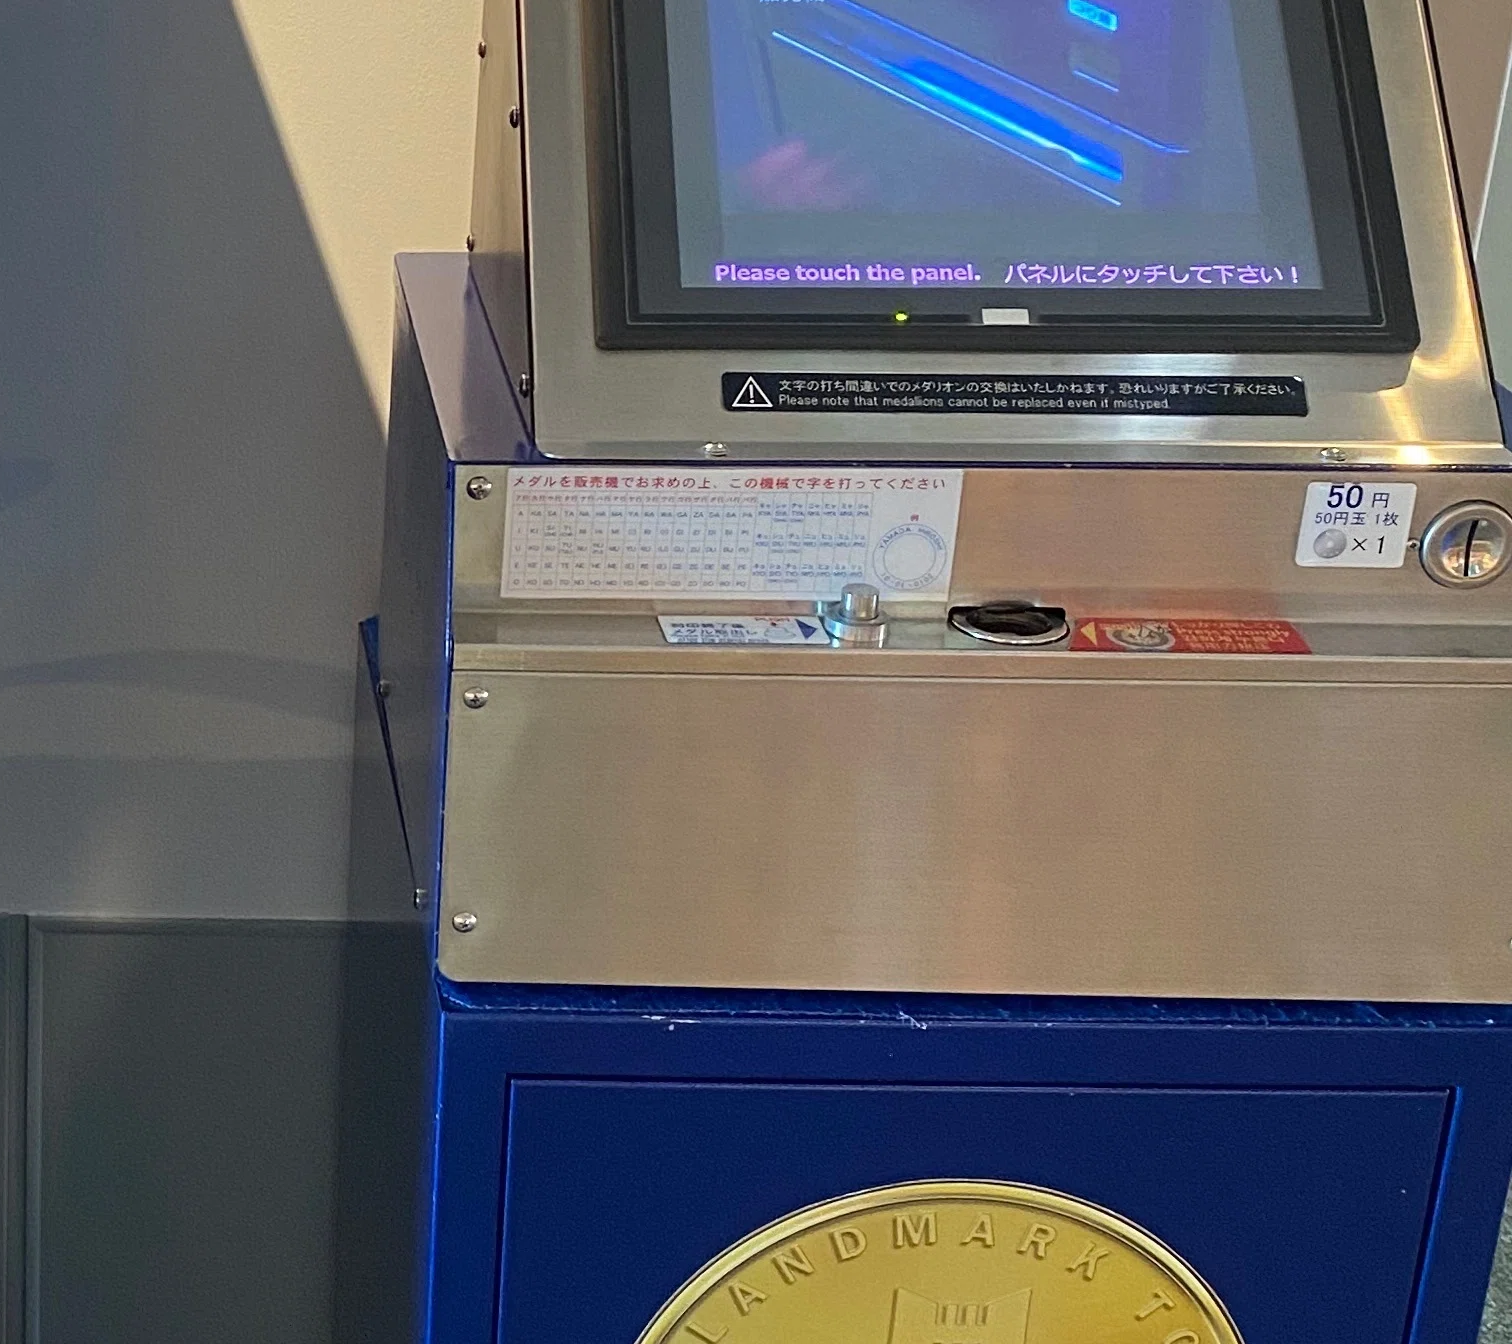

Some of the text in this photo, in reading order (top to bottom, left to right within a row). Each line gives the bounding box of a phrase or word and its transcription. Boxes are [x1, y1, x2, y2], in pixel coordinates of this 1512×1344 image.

[714, 263, 982, 285] Please touch the panel.
[778, 394, 819, 406] Please
[822, 394, 850, 407] note
[854, 394, 879, 407] that
[948, 396, 990, 408] cannot
[992, 396, 1008, 408] be
[1011, 397, 1063, 410] replaced
[1067, 399, 1097, 409] even
[512, 475, 946, 490] メダルを販売機でお求めの上、この機械で字を打ってください
[1326, 484, 1391, 509] 50 円
[1314, 511, 1400, 527] 50円玉 1枚
